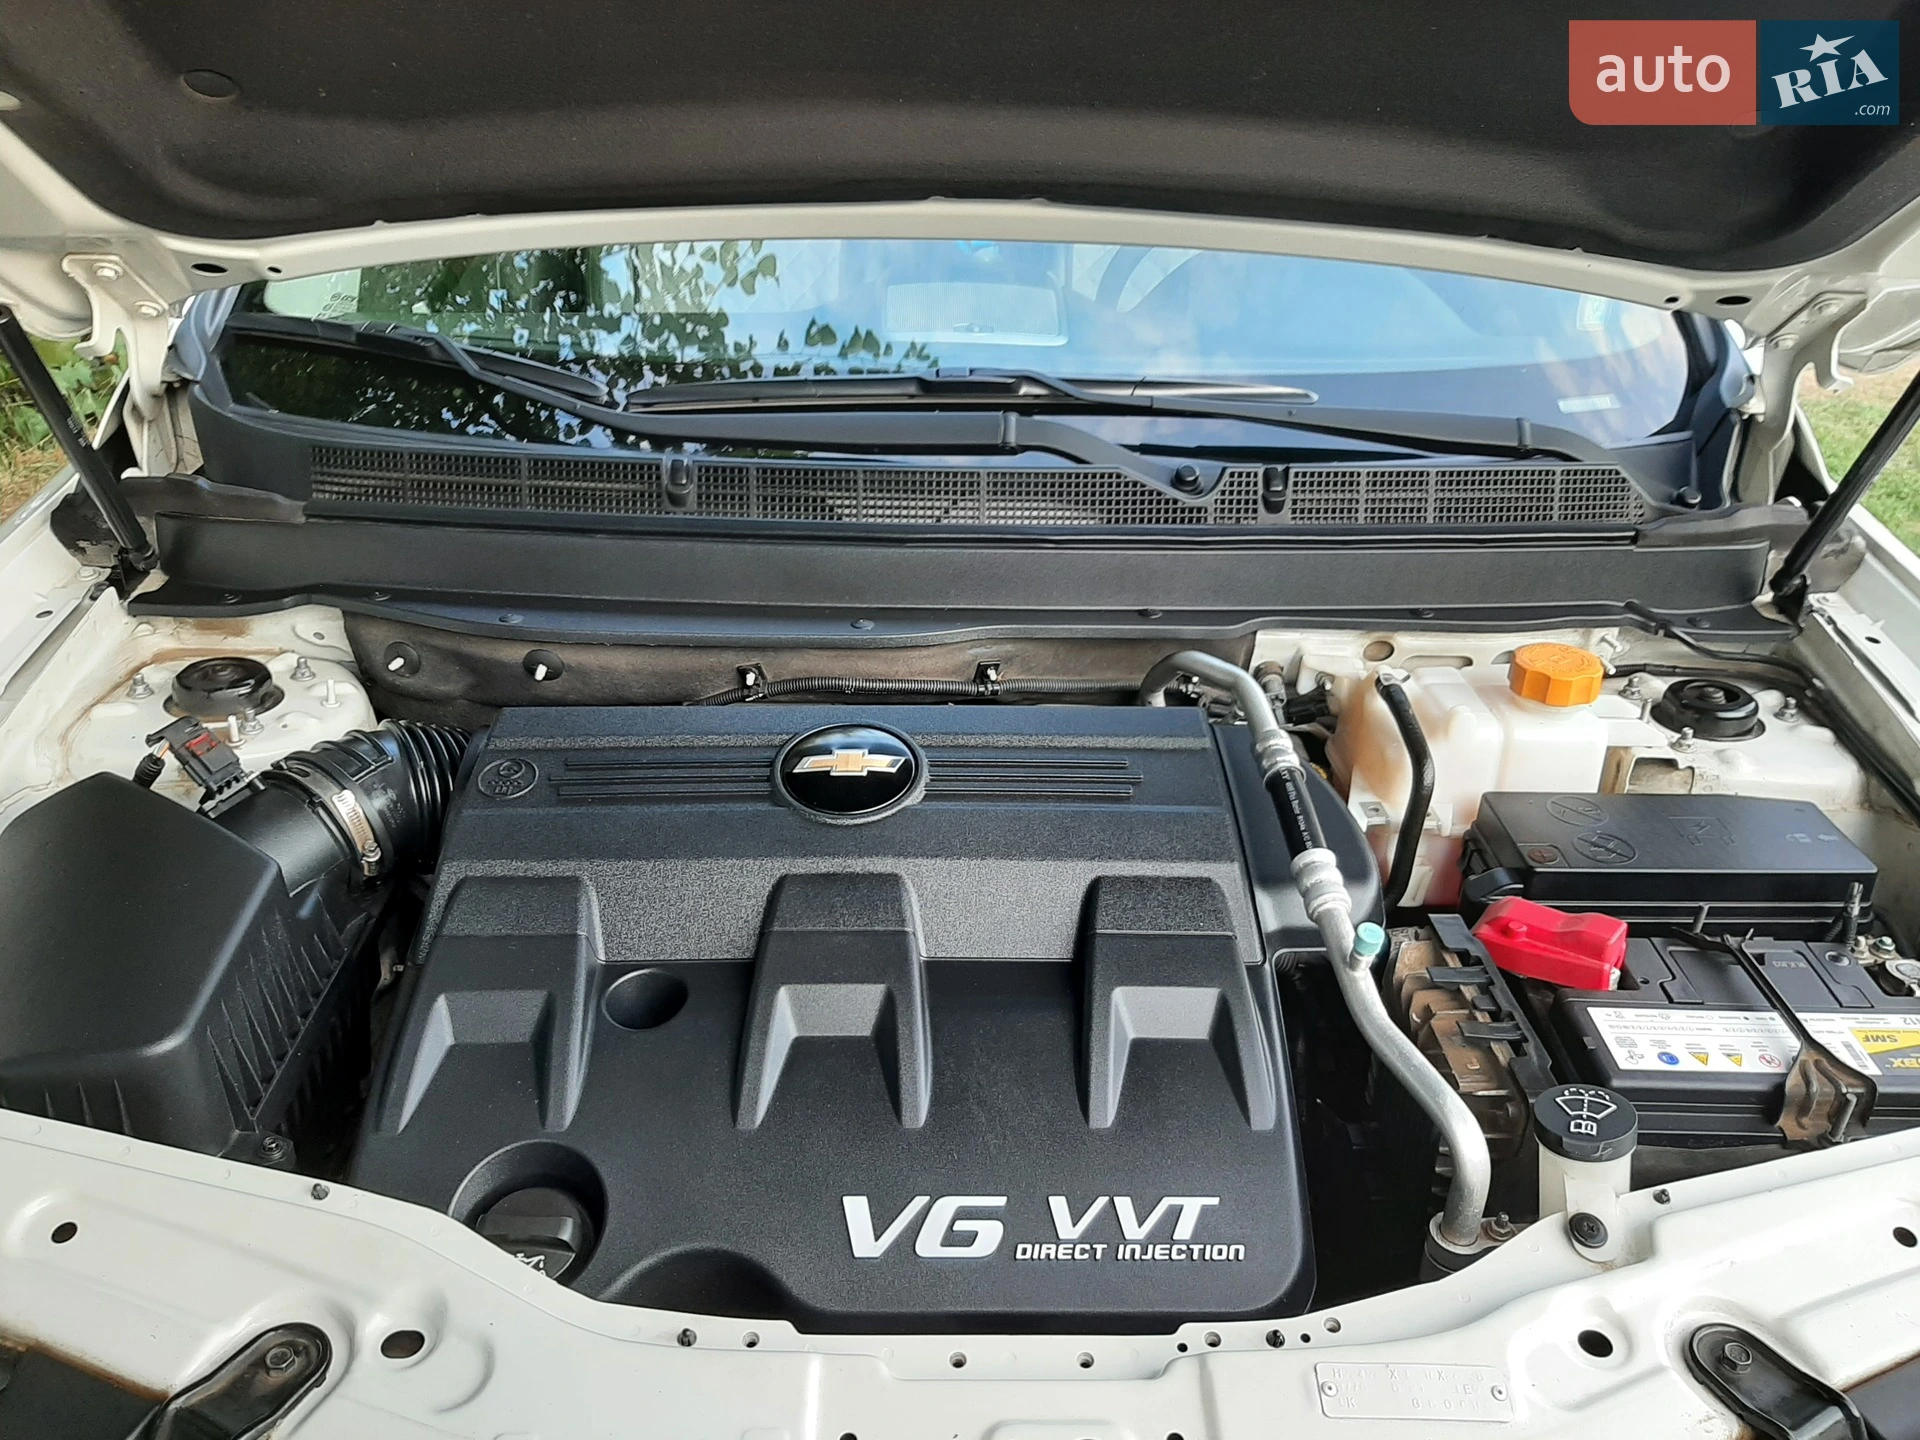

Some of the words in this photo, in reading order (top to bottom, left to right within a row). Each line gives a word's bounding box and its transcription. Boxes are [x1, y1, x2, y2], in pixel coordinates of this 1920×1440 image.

[1862, 1034, 1898, 1043] SMF
[842, 1195, 1007, 1259] V6
[1048, 1195, 1220, 1240] VVT
[1015, 1243, 1108, 1261] DIRECT
[1116, 1243, 1246, 1261] INJECTION
